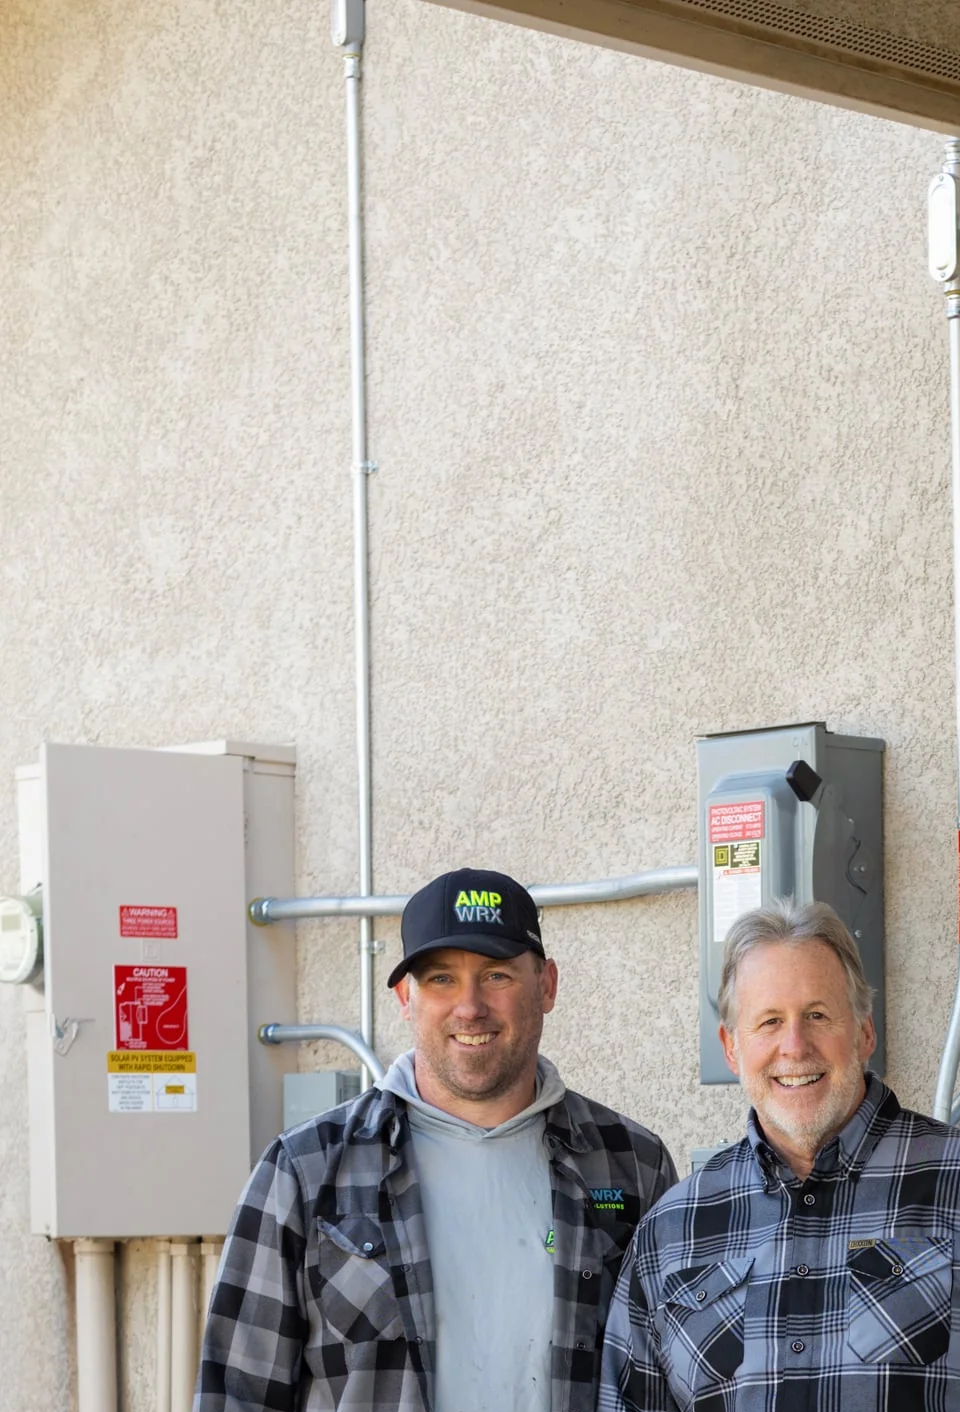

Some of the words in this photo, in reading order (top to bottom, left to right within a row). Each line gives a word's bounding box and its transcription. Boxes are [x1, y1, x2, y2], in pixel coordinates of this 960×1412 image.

[711, 816, 721, 825] AC
[721, 812, 762, 824] DISCONNECT
[455, 890, 502, 908] AMP
[129, 908, 167, 917] WARNING
[455, 906, 504, 925] WRX
[133, 968, 168, 977] CAUTION
[110, 1054, 129, 1062] SOLAR
[142, 1054, 163, 1062] SYSTEM
[164, 1054, 193, 1062] EQUIPPED
[118, 1063, 133, 1071] WITH
[589, 1189, 624, 1202] WRX
